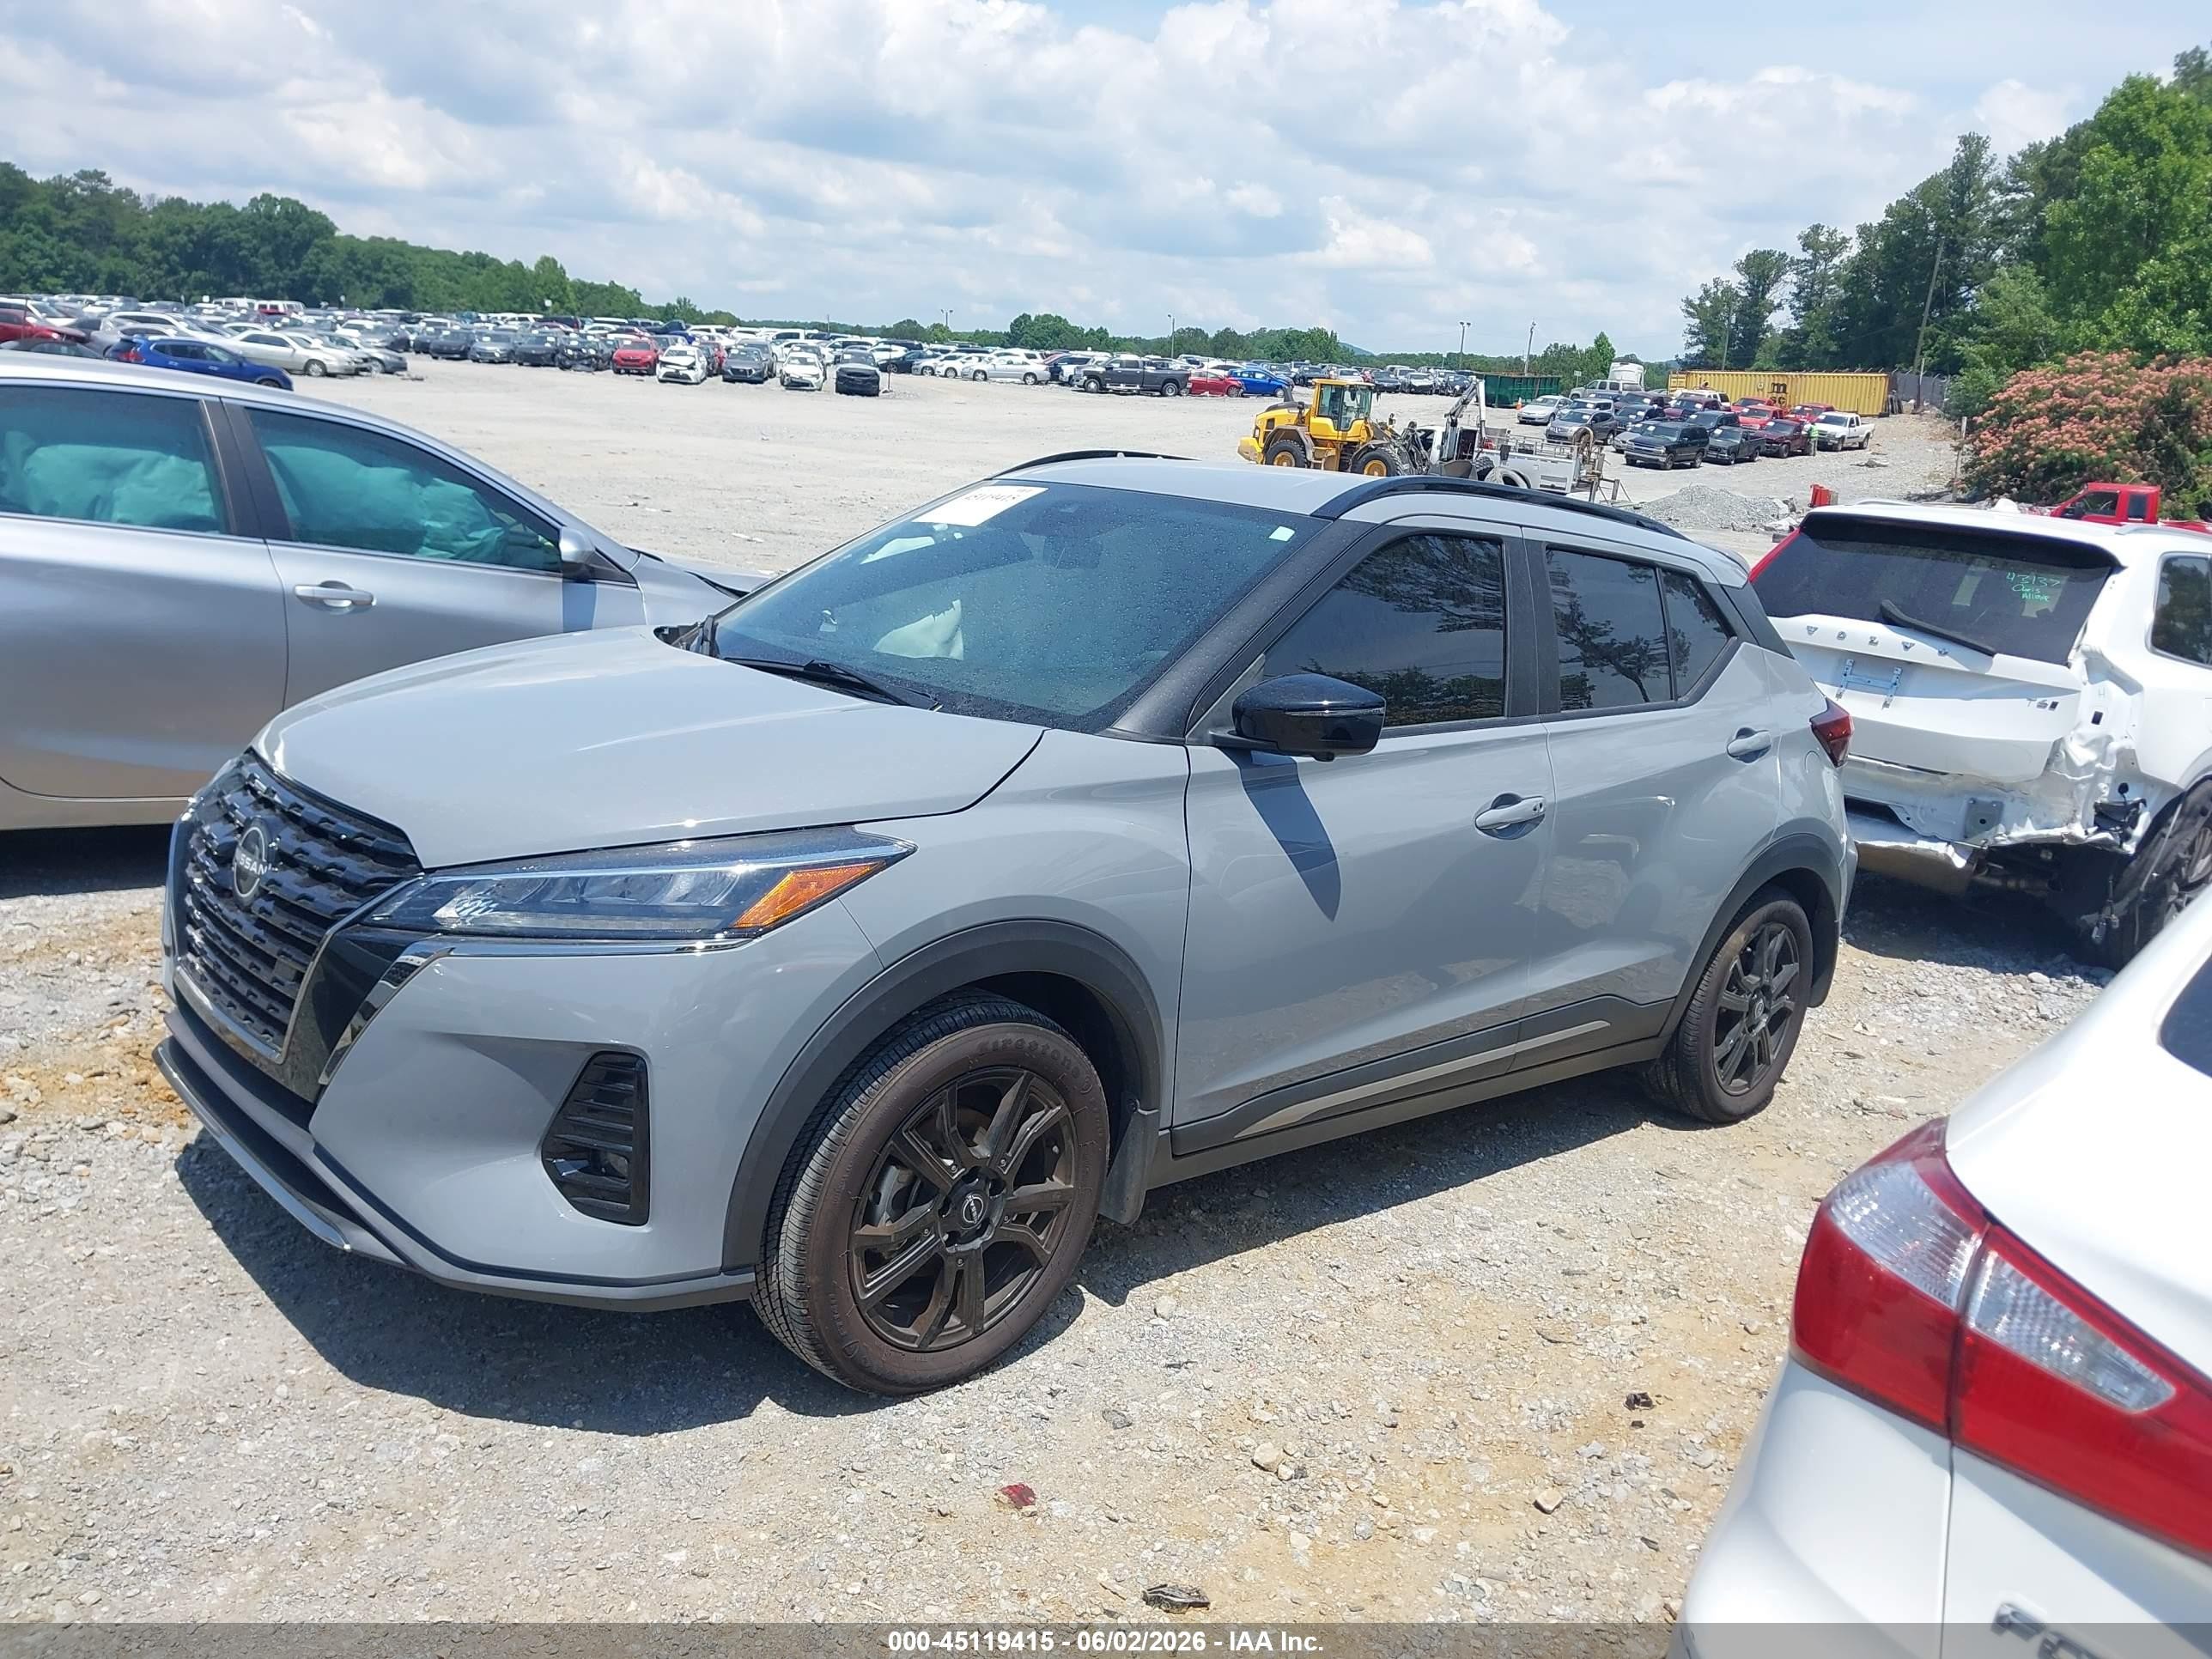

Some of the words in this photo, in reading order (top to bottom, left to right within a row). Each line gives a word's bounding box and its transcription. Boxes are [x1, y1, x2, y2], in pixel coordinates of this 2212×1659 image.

[2006, 572, 2061, 587] 43137
[1806, 625, 1948, 656] VOLVO
[977, 1037, 1080, 1079] Firestone
